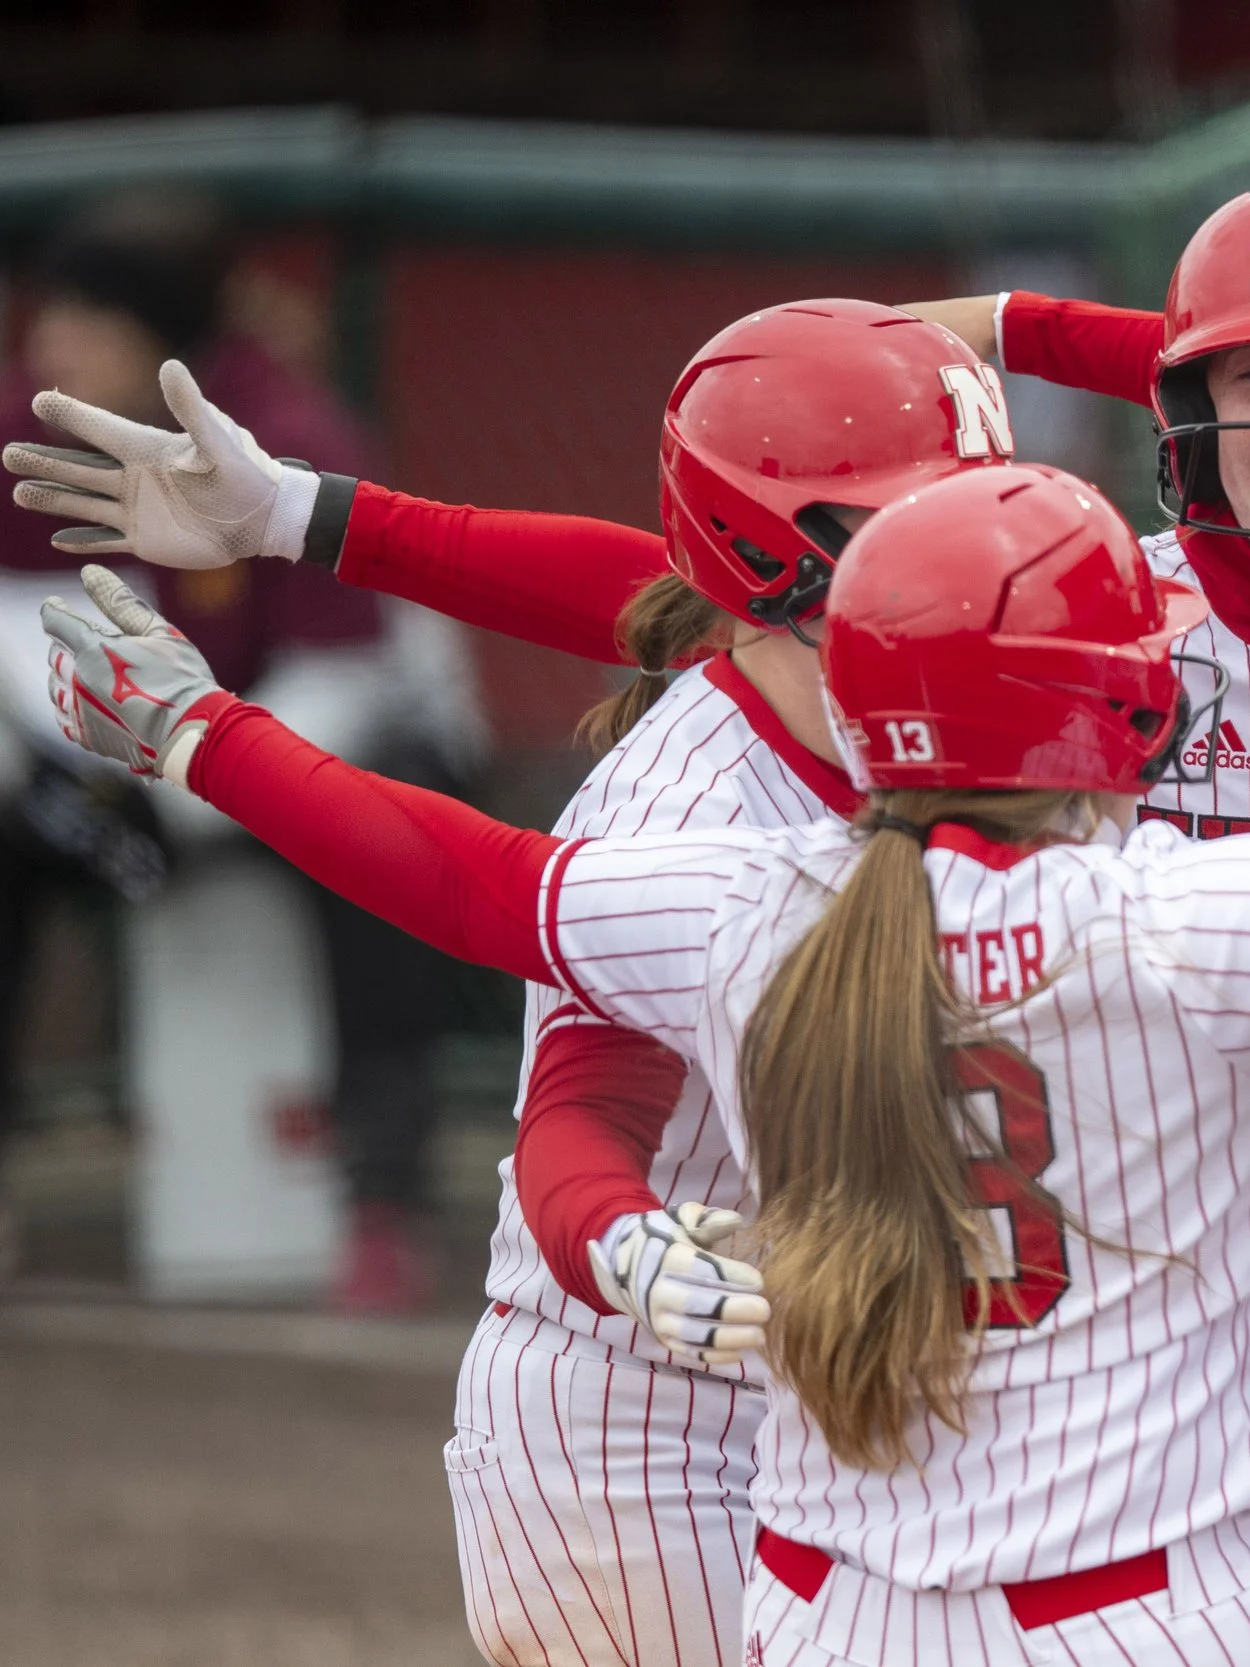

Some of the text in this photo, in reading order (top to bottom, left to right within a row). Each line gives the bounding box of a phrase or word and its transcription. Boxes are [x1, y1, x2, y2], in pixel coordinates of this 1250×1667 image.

[938, 363, 1014, 458] N
[884, 720, 935, 763] 13
[936, 921, 1048, 1005] TER
